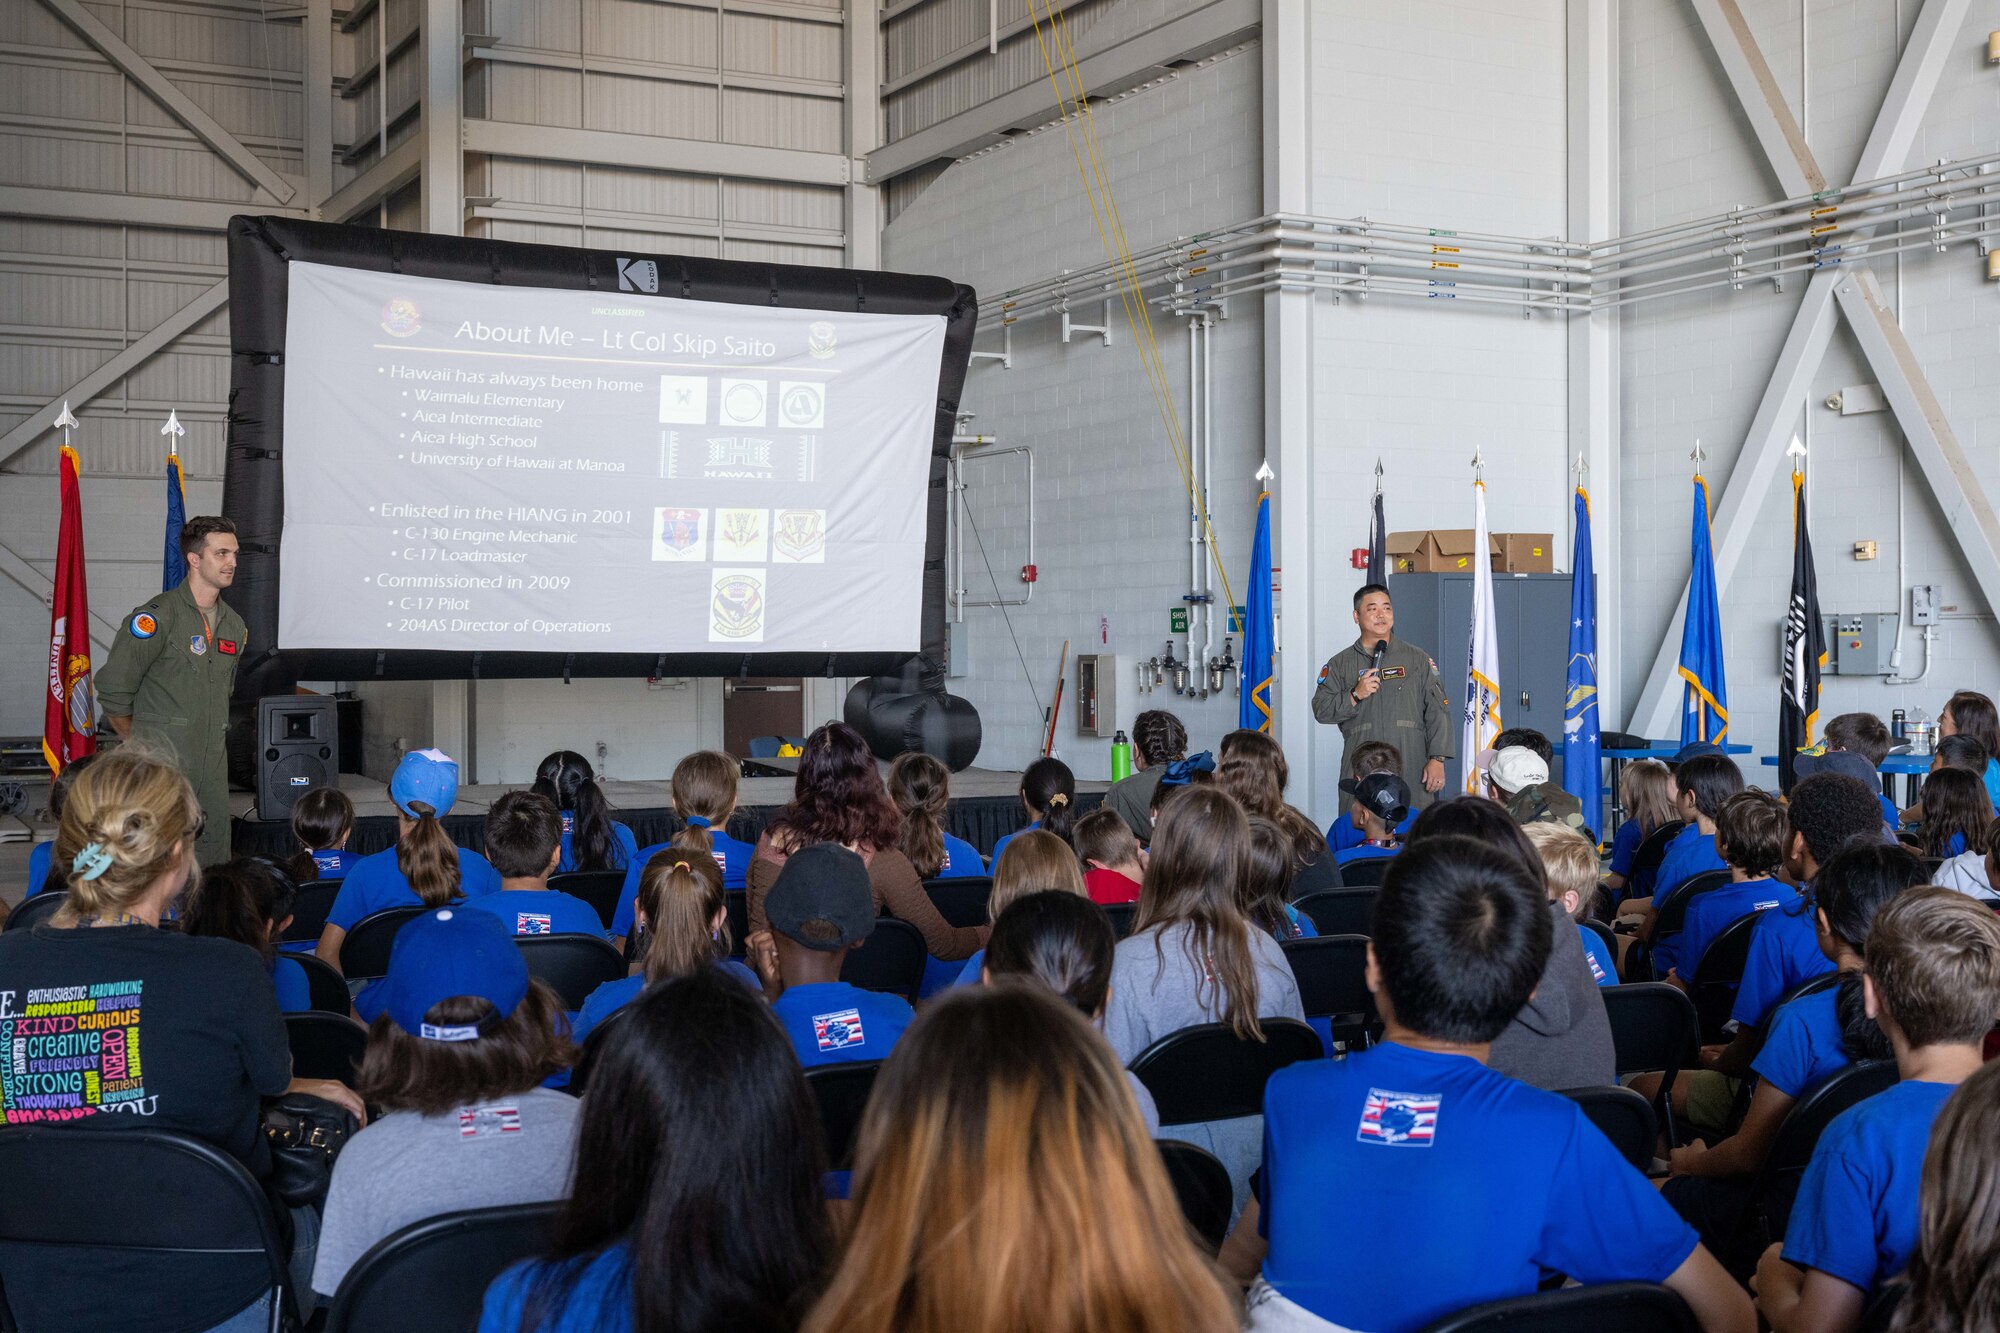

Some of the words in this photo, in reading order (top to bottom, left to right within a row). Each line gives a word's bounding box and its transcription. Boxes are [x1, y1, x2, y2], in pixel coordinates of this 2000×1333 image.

[647, 262, 656, 290] KODAK
[592, 307, 645, 317] UNCLASSIFIED
[455, 321, 531, 344] About
[538, 325, 574, 346] Me
[603, 329, 623, 349] Lt
[630, 331, 665, 351] Col
[673, 333, 716, 359] Skip
[724, 336, 775, 357] Saito
[391, 365, 450, 382] Hawaii
[456, 369, 484, 384] has
[490, 372, 546, 391] always
[551, 374, 592, 390] been
[597, 376, 644, 392] home
[414, 388, 479, 405] Waimalu
[484, 392, 565, 412] Elementary
[412, 409, 446, 424] Aiea
[450, 411, 543, 428] Intermediate
[411, 430, 445, 445] Aiea
[450, 432, 485, 450] High
[489, 434, 537, 449] School
[411, 451, 483, 471] University
[487, 454, 503, 468] of
[505, 455, 555, 470] Hawaii
[558, 459, 573, 471] at
[576, 458, 625, 472] Manoa
[381, 502, 449, 520] Enlisted
[454, 505, 469, 520] in
[475, 506, 503, 521] the
[508, 507, 567, 522] HIANG
[571, 508, 587, 523] in
[591, 510, 631, 524] 2001
[405, 527, 449, 541] C-130
[453, 528, 505, 545] Engine
[509, 530, 578, 544] Mechanic
[403, 548, 437, 561] C-17
[441, 548, 528, 563] Loadmaster
[377, 573, 502, 589] Commissioned
[507, 575, 522, 590] in
[527, 576, 571, 590] 2009
[400, 597, 434, 611] C-17
[438, 597, 470, 611] Pilot
[1172, 611, 1187, 619] SHOP
[399, 618, 447, 633] 204AS
[451, 619, 510, 633] Director
[513, 619, 530, 633] of
[532, 619, 611, 636] Operations
[51, 642, 64, 700] UNITED
[89, 980, 143, 998] HARDWORKING
[96, 995, 141, 1012] HELPFUL
[14, 1015, 77, 1036] KIND
[13, 1037, 27, 1075] BRAVE
[29, 1055, 99, 1073] FRIENDLY
[102, 1029, 126, 1079] OPEN
[1, 1020, 16, 1109] CONFIDENT
[84, 1071, 101, 1105] HONEST
[15, 1092, 82, 1110] THOUGHTFUL
